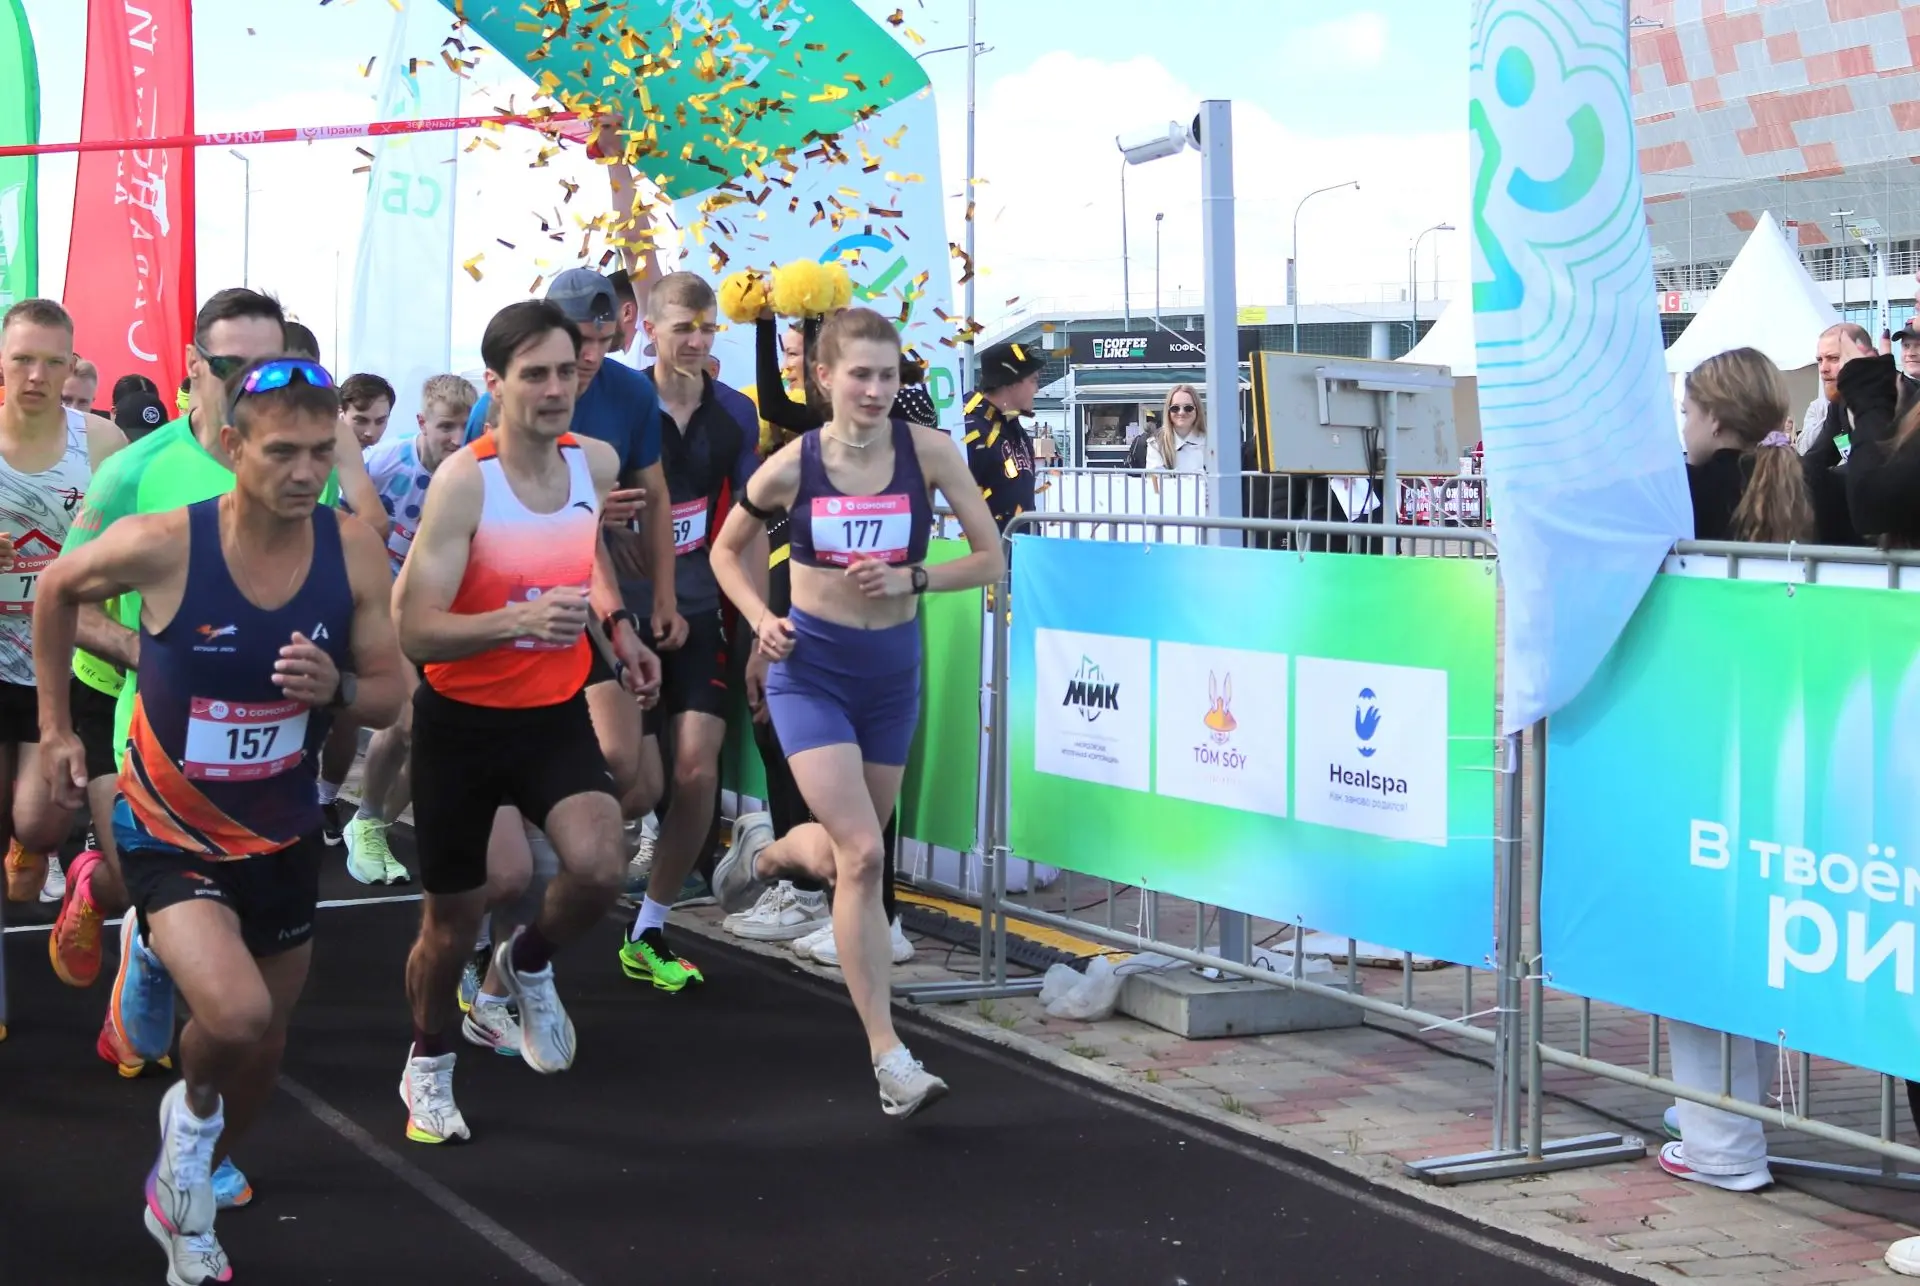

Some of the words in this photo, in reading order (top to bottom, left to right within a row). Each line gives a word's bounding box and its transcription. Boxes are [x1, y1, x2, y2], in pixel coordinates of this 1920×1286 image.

[1104, 337, 1148, 348] COFFEE
[1104, 347, 1131, 358] LIKE
[1169, 343, 1195, 352] КОФЕ
[842, 519, 883, 549] 177
[20, 575, 38, 599] 7
[1062, 679, 1120, 711] МИК
[226, 725, 280, 761] 157
[1330, 763, 1408, 795] Healspa
[1690, 819, 1731, 870] В
